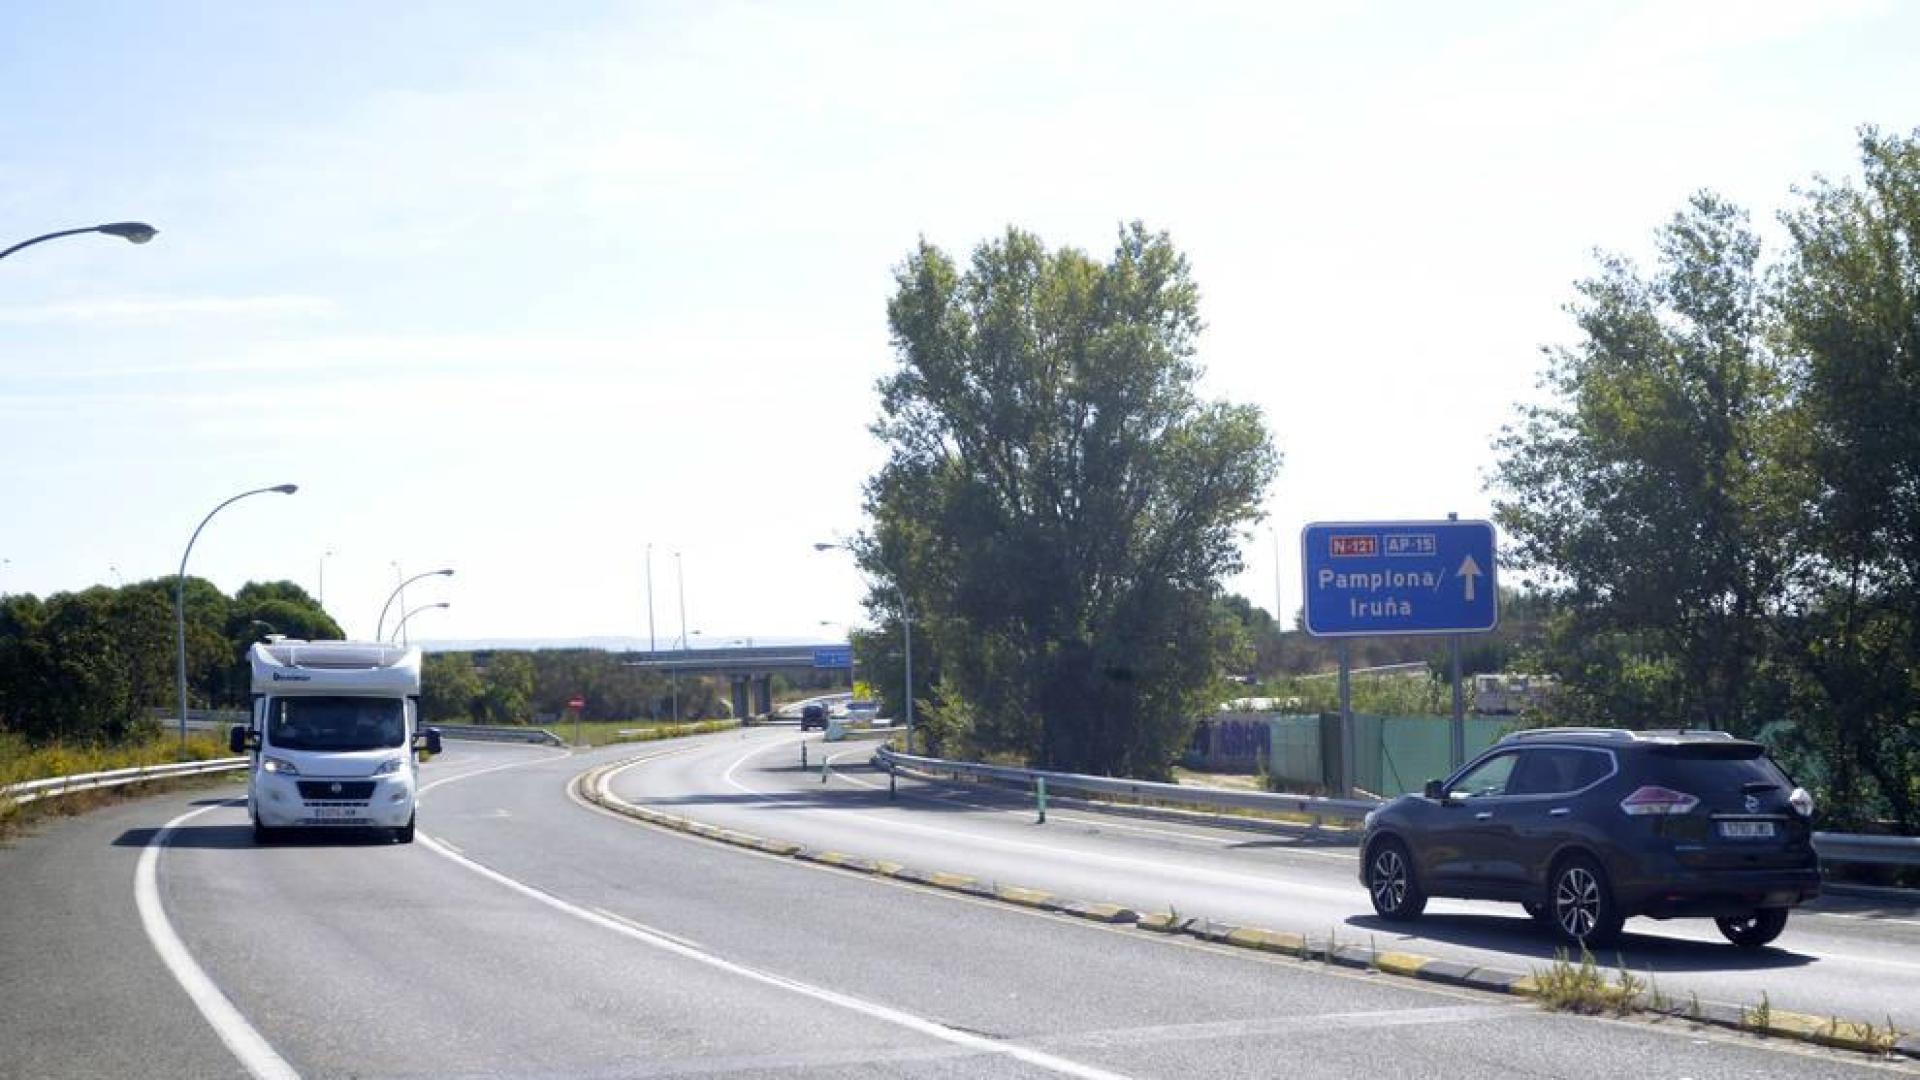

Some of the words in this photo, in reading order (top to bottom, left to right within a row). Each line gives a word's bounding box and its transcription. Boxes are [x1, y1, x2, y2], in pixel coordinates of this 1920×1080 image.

[1333, 538, 1375, 555] N-121
[1388, 537, 1433, 553] AP-15
[1319, 568, 1446, 593] Pamplona/
[1351, 597, 1412, 618] Iruña
